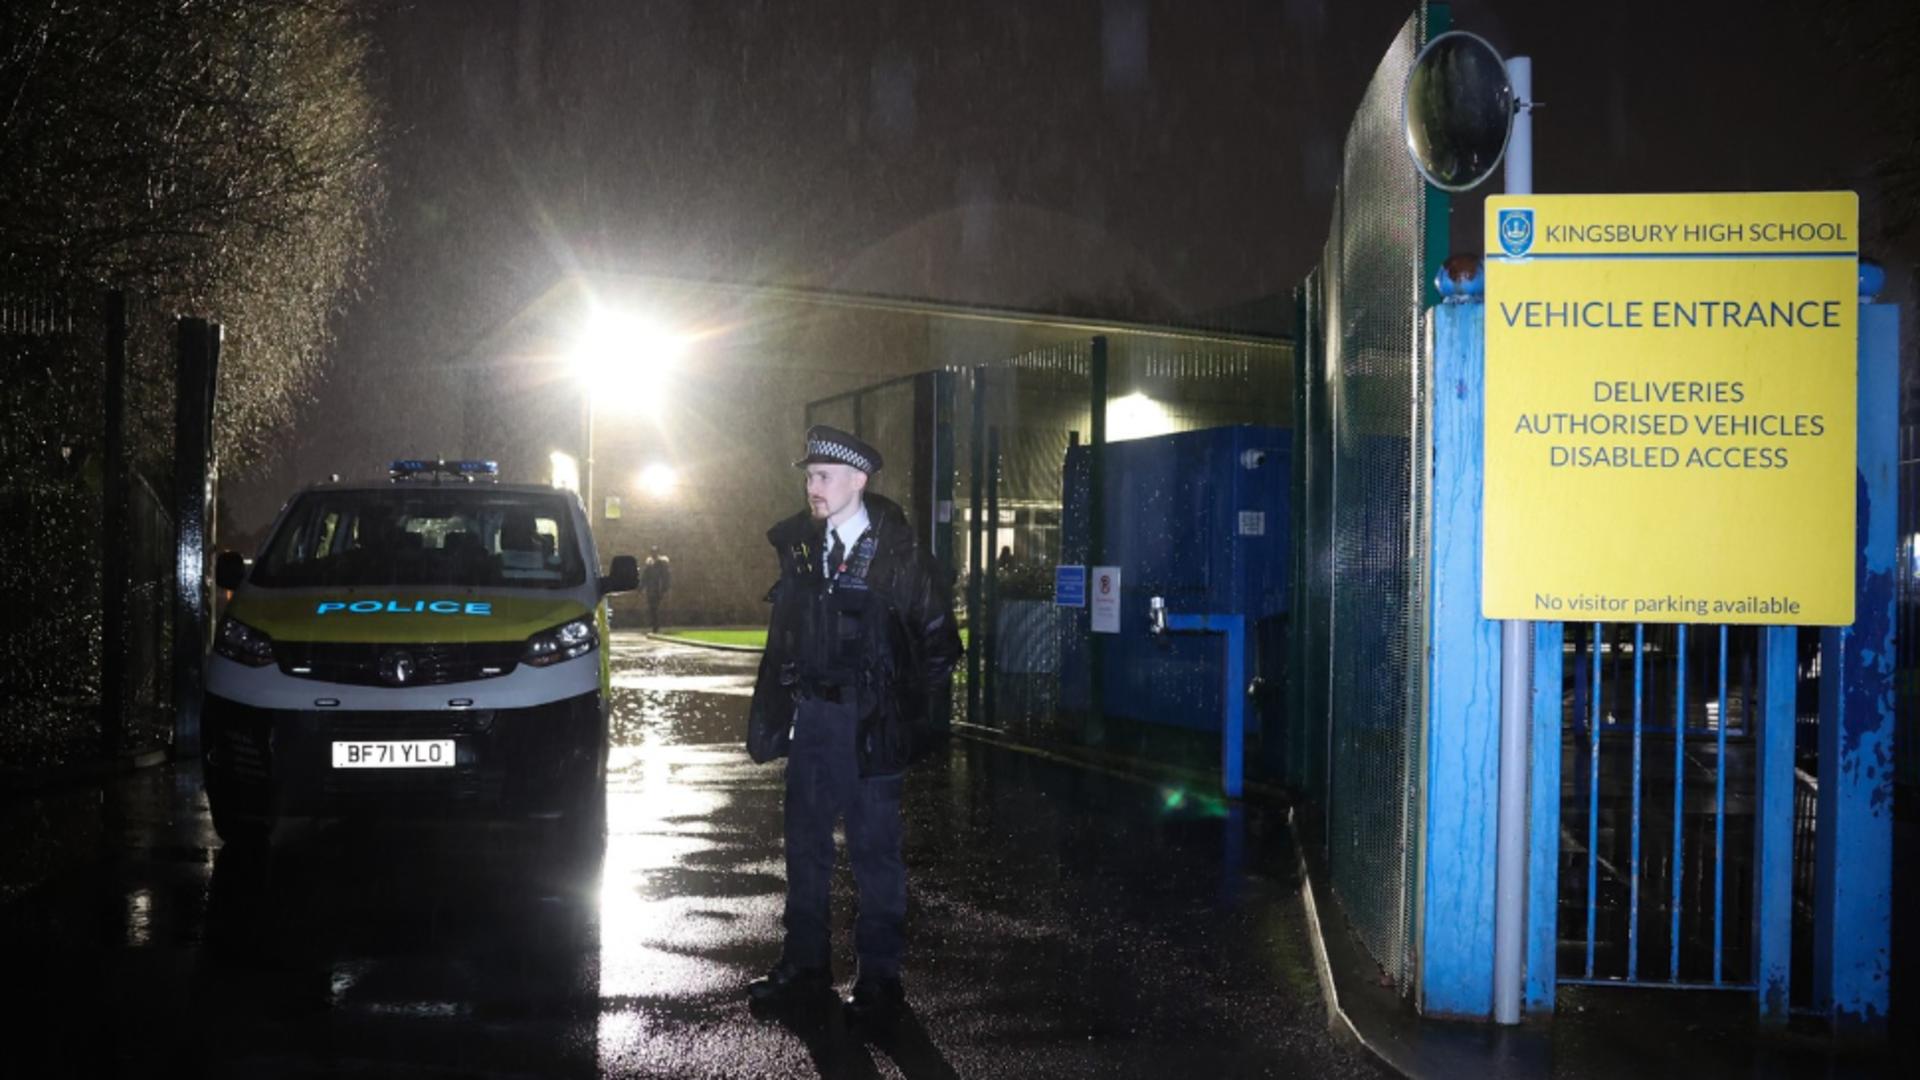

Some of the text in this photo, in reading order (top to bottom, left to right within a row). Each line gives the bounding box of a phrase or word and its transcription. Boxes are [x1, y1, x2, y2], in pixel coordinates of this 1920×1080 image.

[1546, 222, 1847, 243] KINGSBURY HIGH SCHOOL
[1500, 300, 1841, 328] VEHICLE ENTRANCE
[1594, 381, 1745, 403] DELIVERIES
[1515, 414, 1825, 436] AUTHORISED VEHICLES
[1550, 446, 1789, 469] DISABLED ACCESS
[317, 600, 492, 616] POLICE
[1535, 593, 1801, 616] No visitor parking available
[347, 743, 442, 763] BF71 YLO
